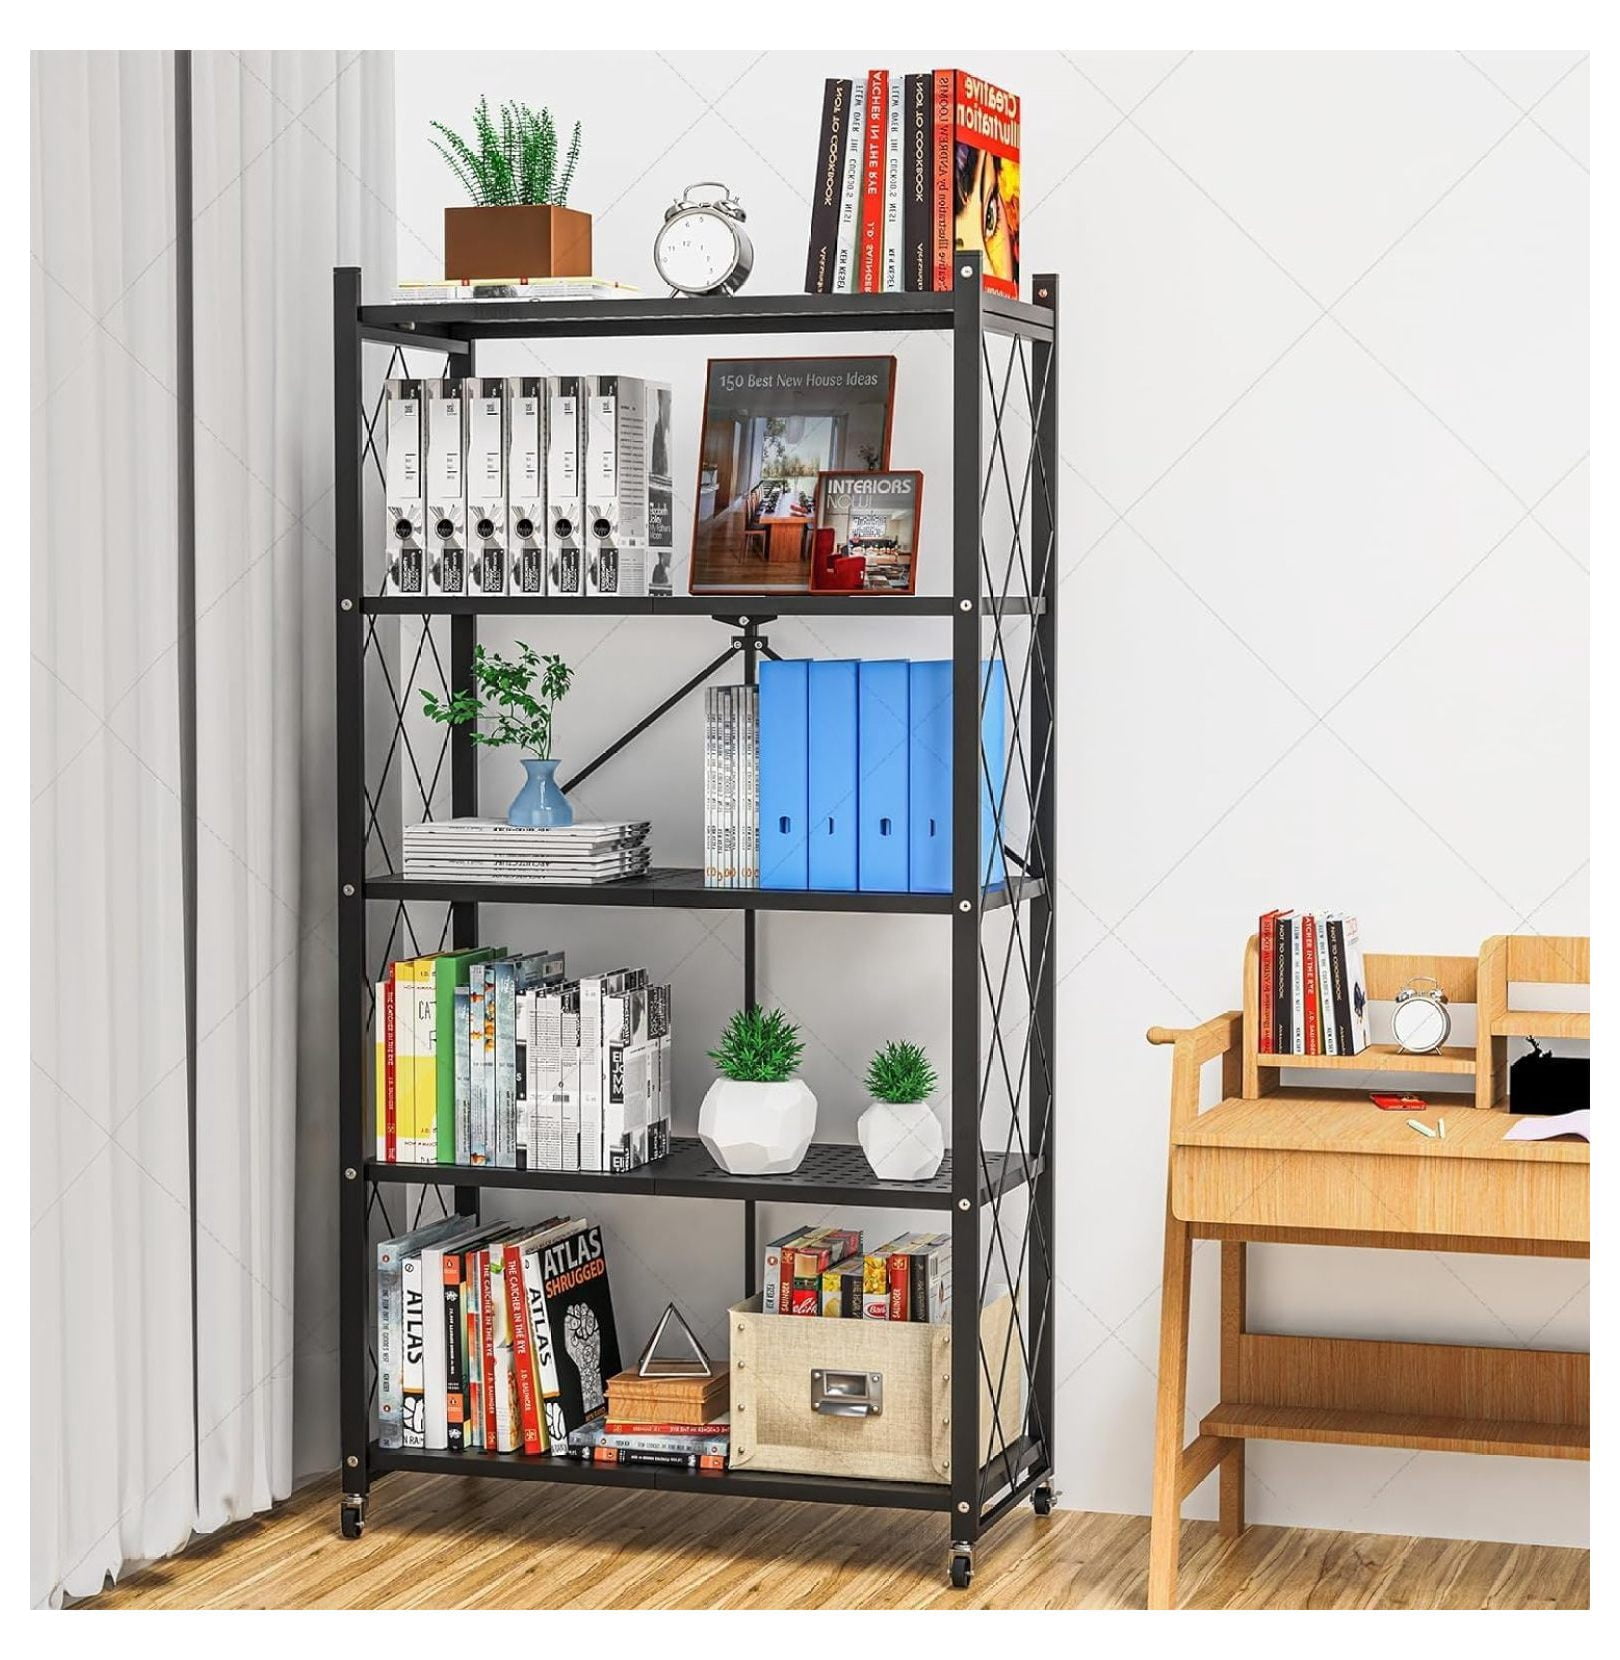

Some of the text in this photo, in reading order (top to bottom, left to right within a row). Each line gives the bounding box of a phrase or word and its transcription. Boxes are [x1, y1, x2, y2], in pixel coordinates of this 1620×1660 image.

[720, 372, 878, 391] 150 Best New House Ideas
[828, 479, 912, 495] INTERIORS
[544, 1229, 601, 1280] ATLAS
[508, 1260, 517, 1275] THE
[545, 1258, 605, 1299] SHRUGGED
[510, 1276, 522, 1313] CATCHER
[407, 1290, 423, 1365] ATLAS
[514, 1313, 522, 1324] IN
[529, 1288, 552, 1367] ATLAS
[515, 1324, 525, 1339] THE
[517, 1340, 527, 1355] RYE
